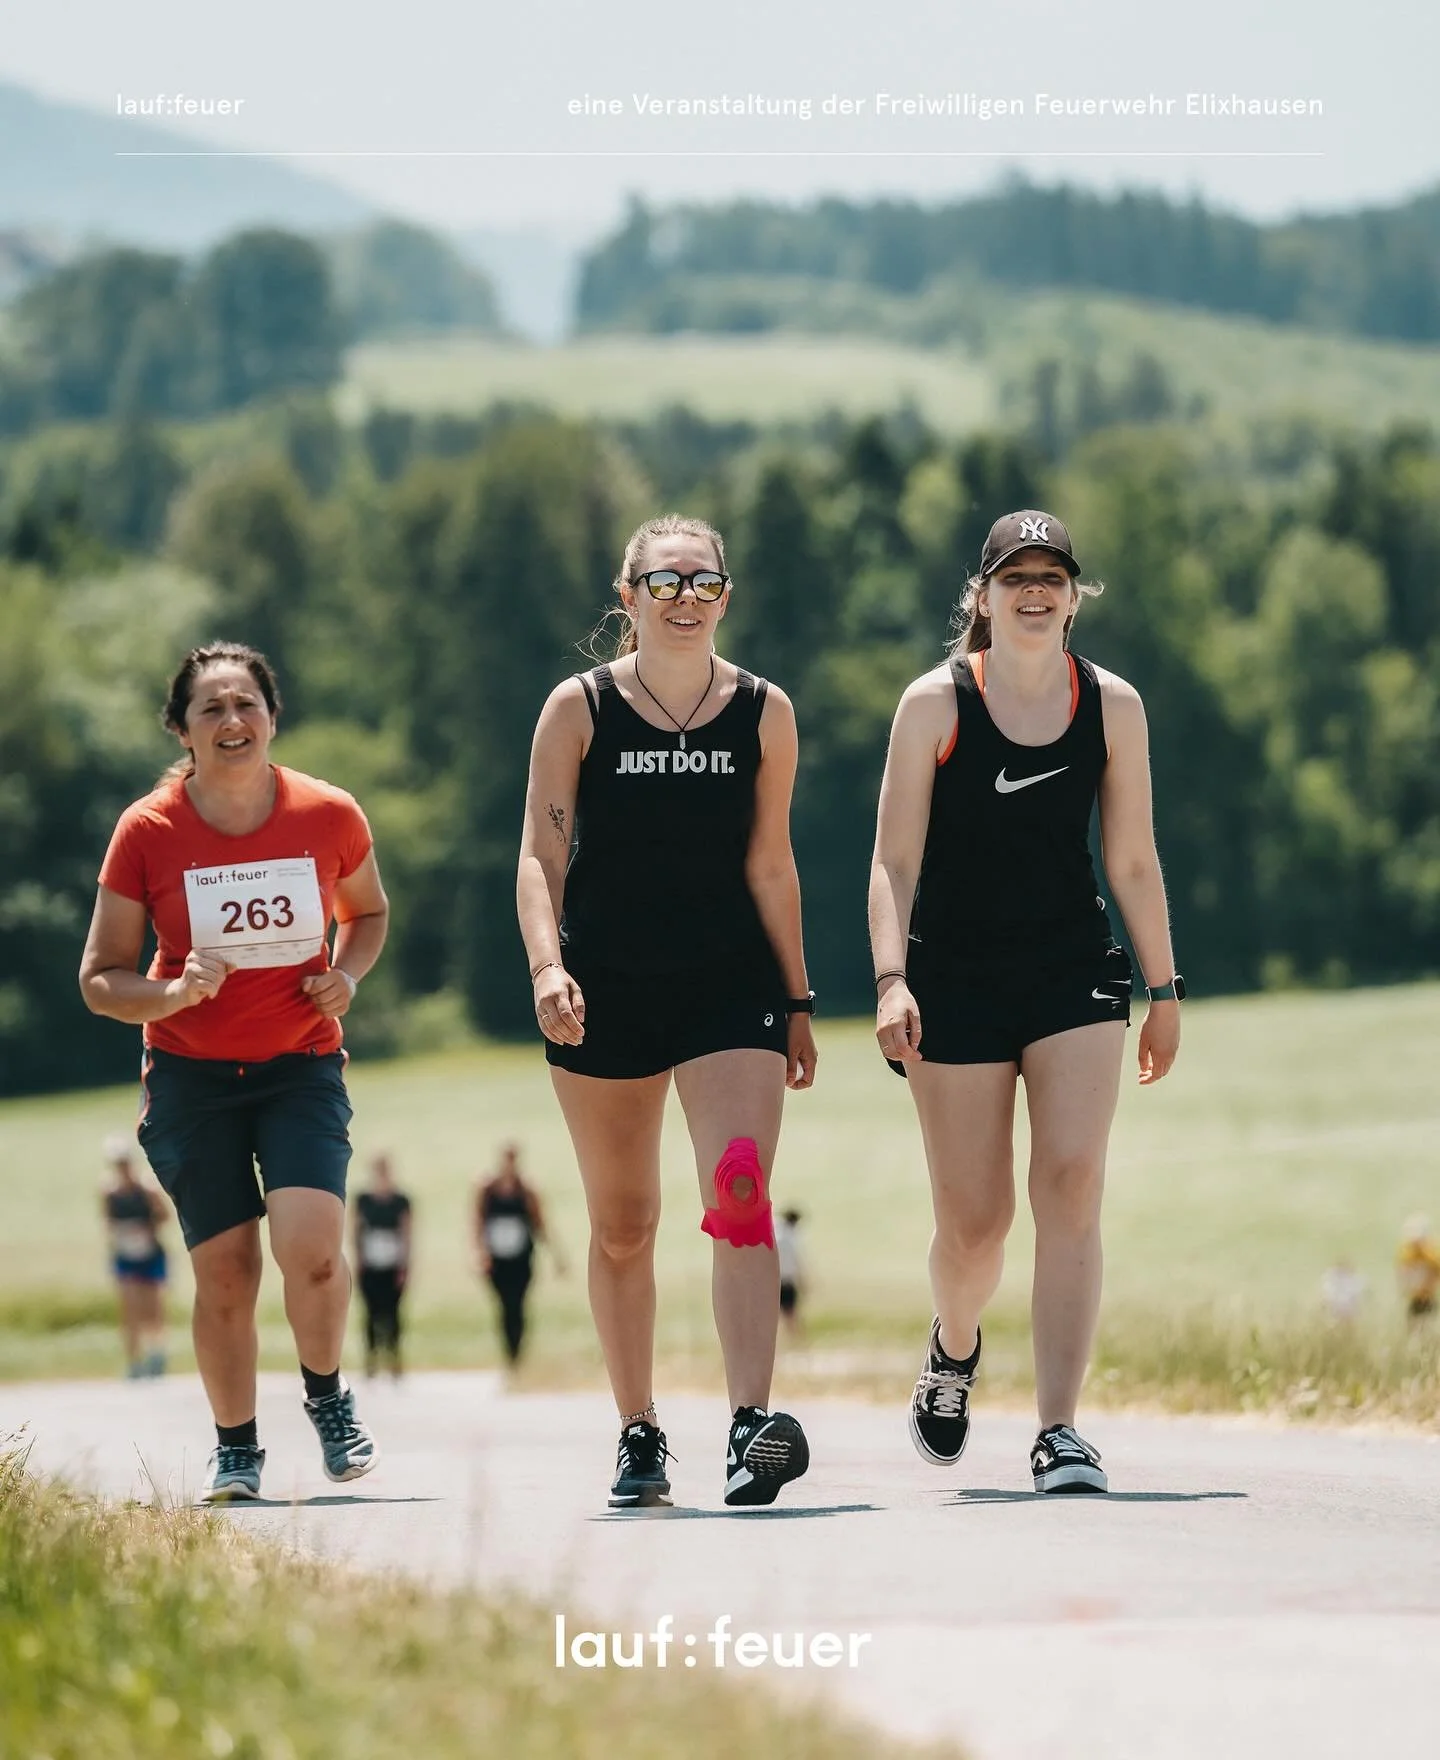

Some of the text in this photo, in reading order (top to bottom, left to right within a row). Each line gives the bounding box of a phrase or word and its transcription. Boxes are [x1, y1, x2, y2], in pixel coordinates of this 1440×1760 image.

[616, 750, 735, 774] JUST DO IT.
[196, 869, 268, 886] lauf:feuer
[220, 895, 294, 934] 263
